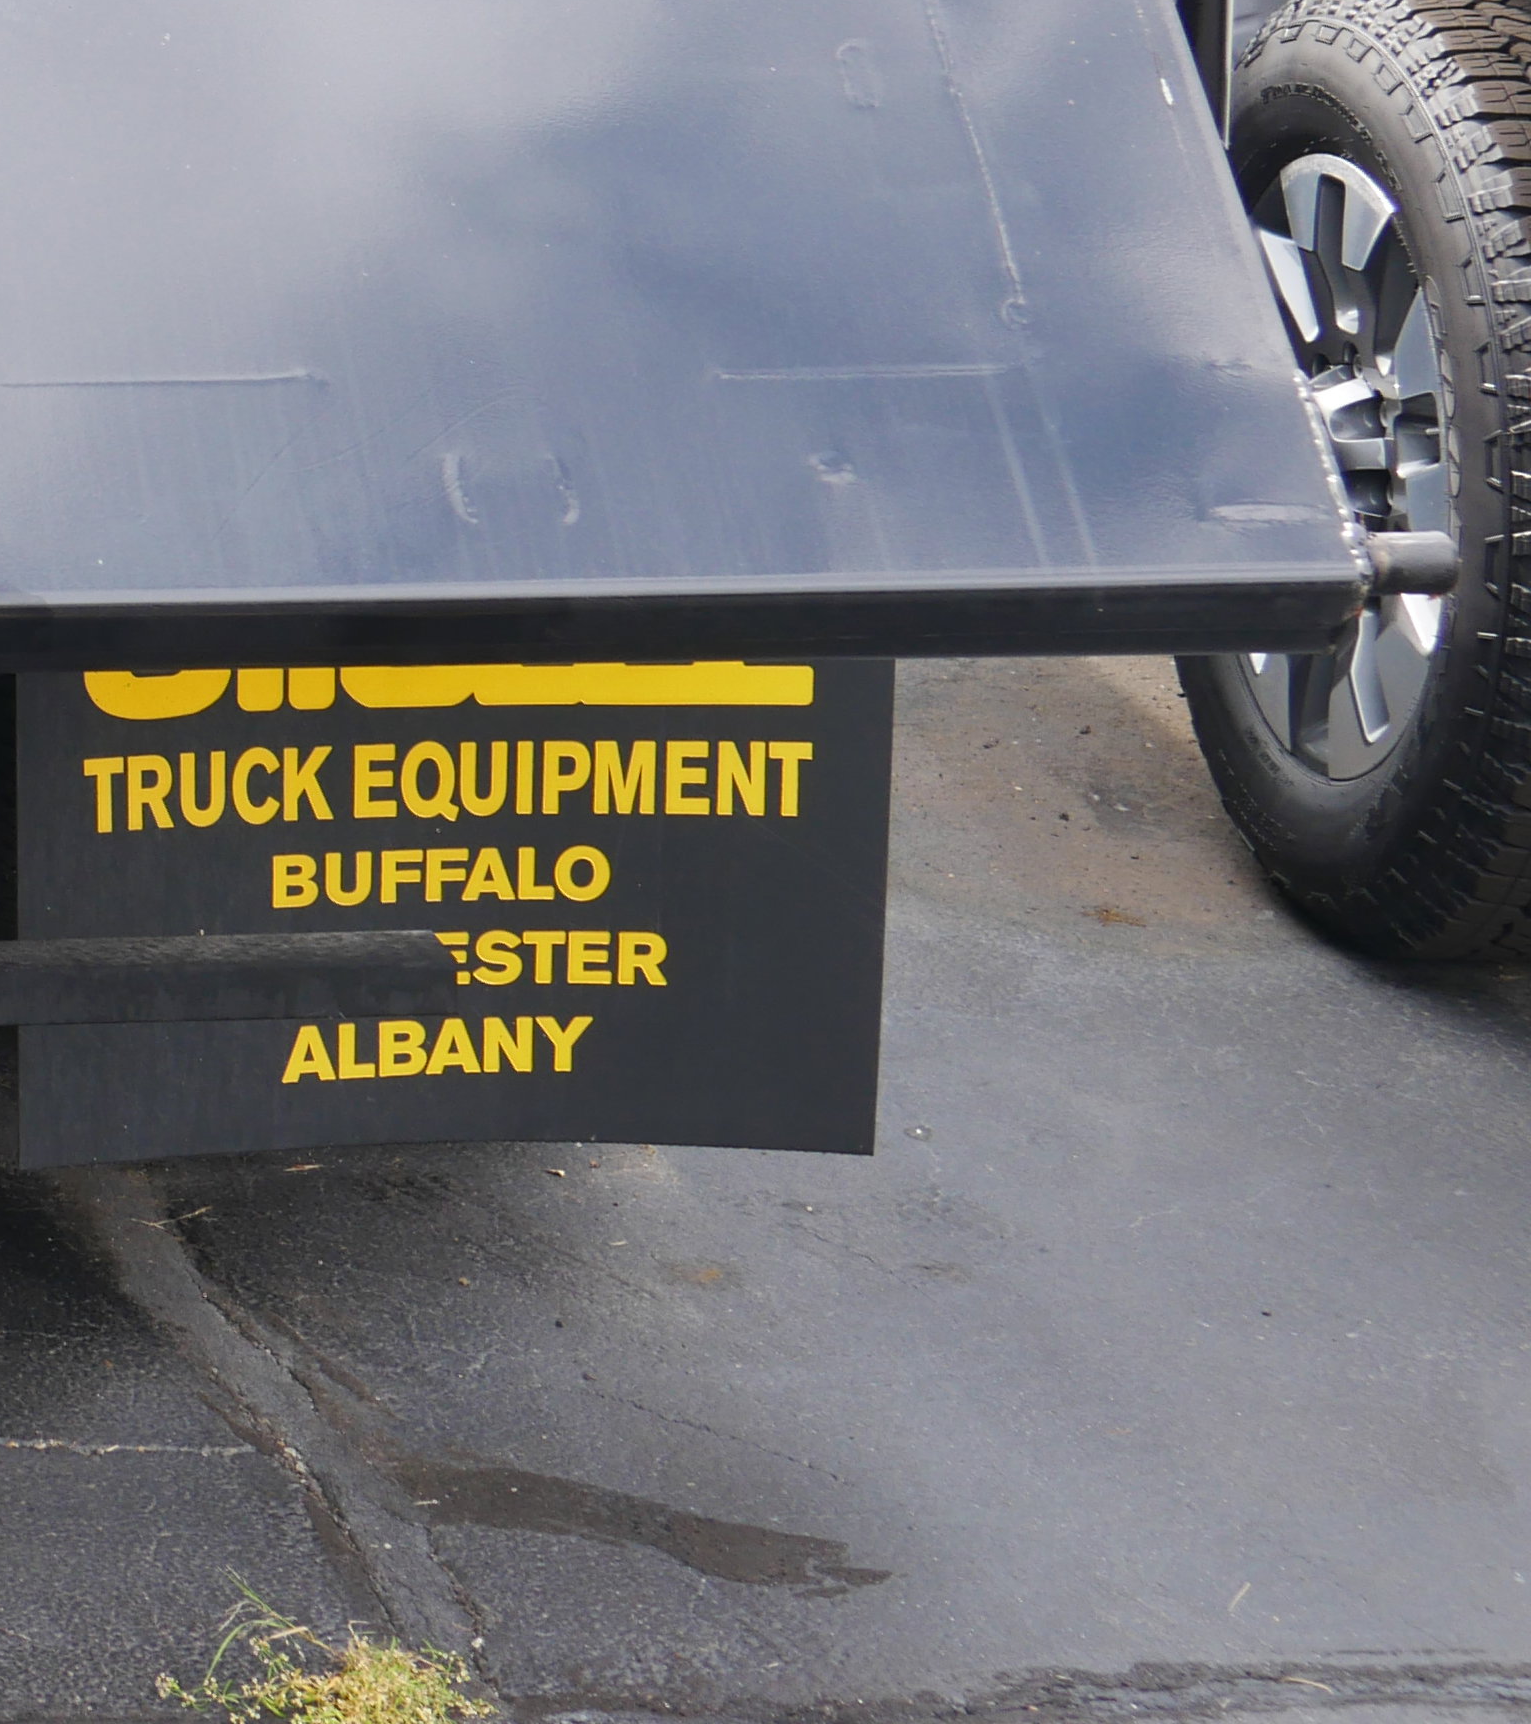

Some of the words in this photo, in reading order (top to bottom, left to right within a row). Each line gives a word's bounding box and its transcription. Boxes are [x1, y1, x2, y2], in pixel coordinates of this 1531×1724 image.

[82, 745, 334, 834] TRUCK
[352, 739, 813, 822] EQUIPMENT
[271, 844, 611, 909] BUFFALO
[282, 1015, 593, 1085] ALBANY
